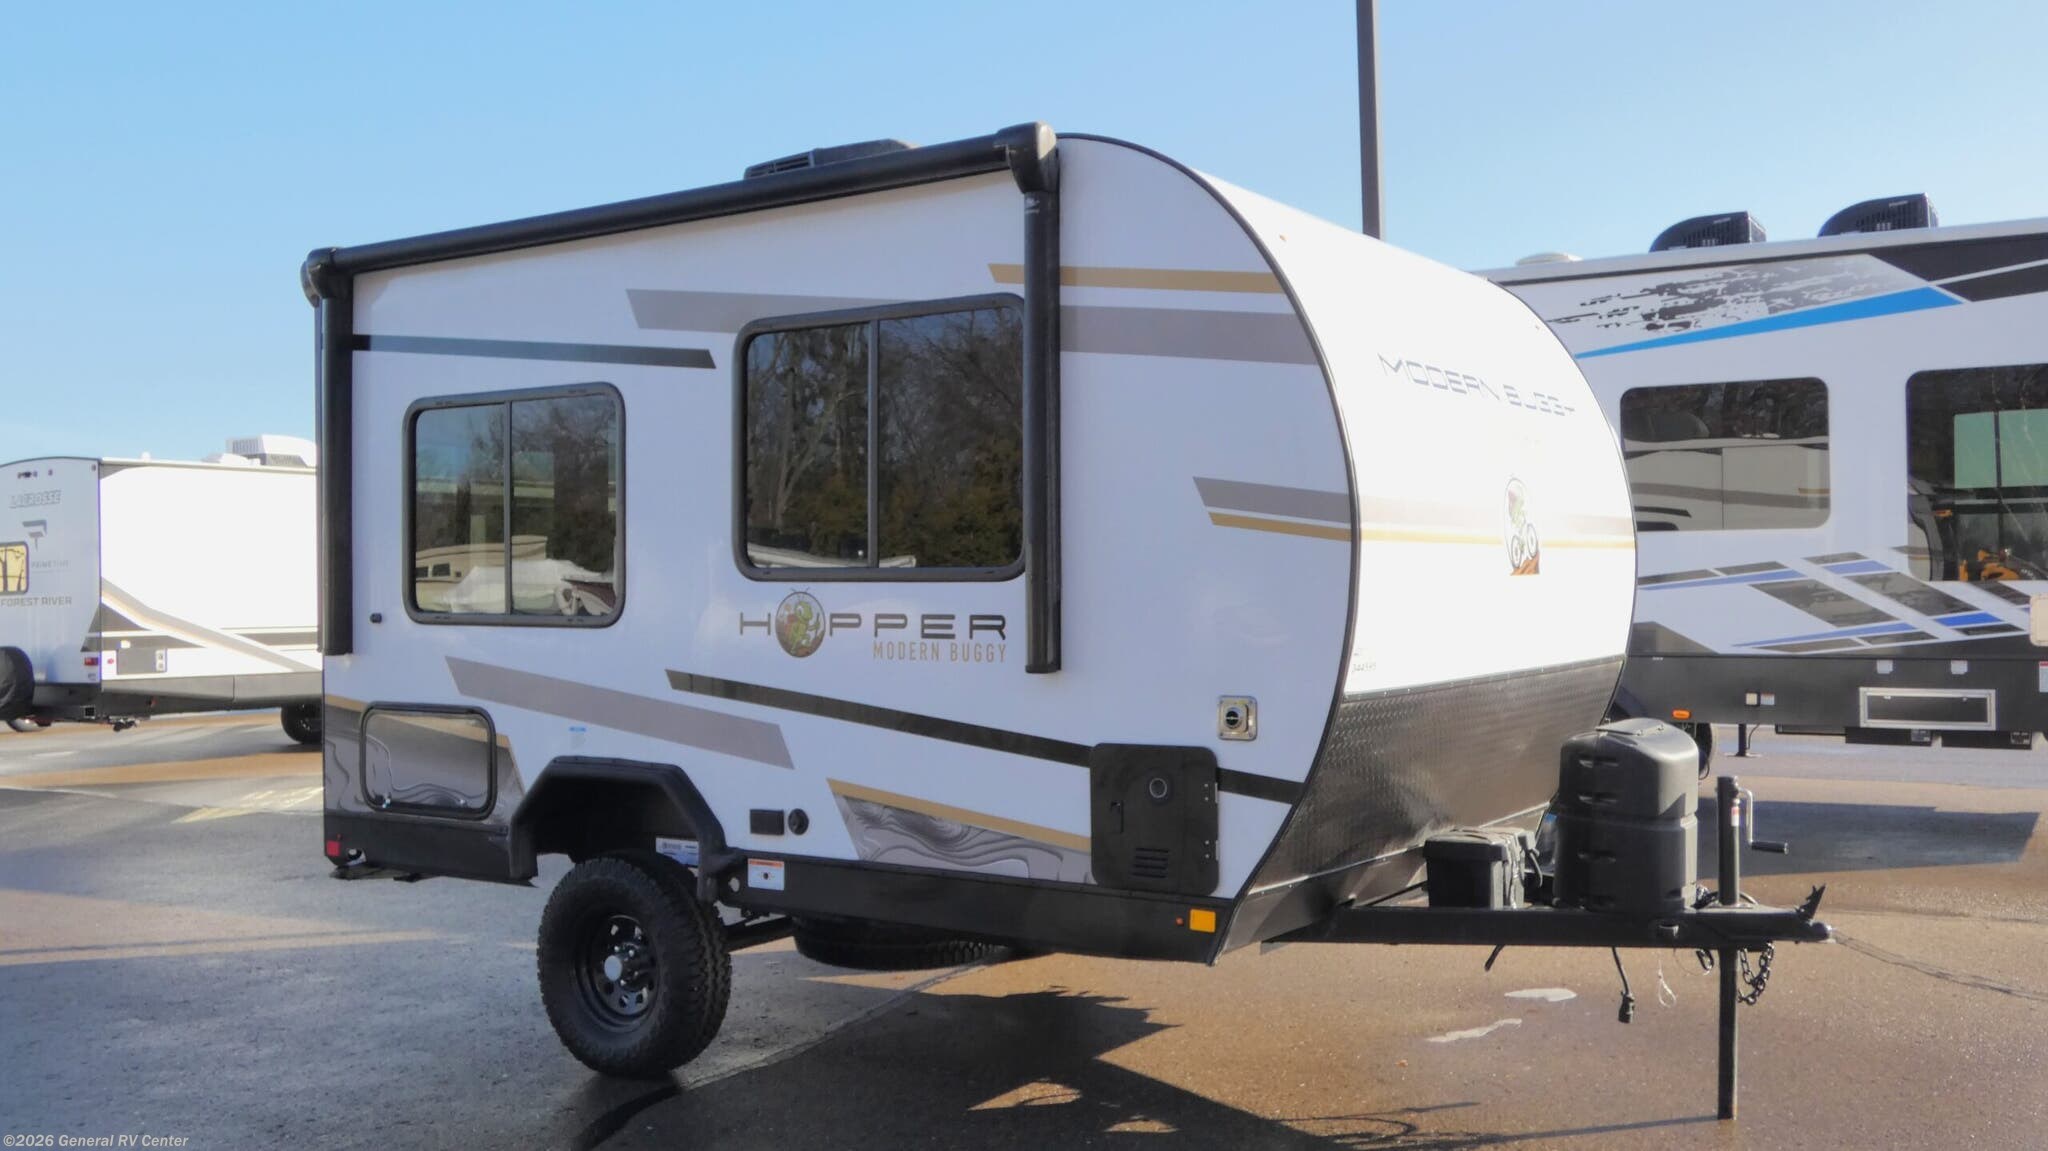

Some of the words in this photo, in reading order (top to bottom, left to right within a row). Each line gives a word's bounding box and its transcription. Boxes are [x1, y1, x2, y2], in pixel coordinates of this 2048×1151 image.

[1377, 353, 1501, 401] MODERN
[0, 597, 40, 607] FOREST
[41, 596, 72, 606] RIVER
[740, 591, 1006, 658] HOPPER
[873, 641, 941, 661] MODERN
[950, 642, 1007, 663] BUGGY
